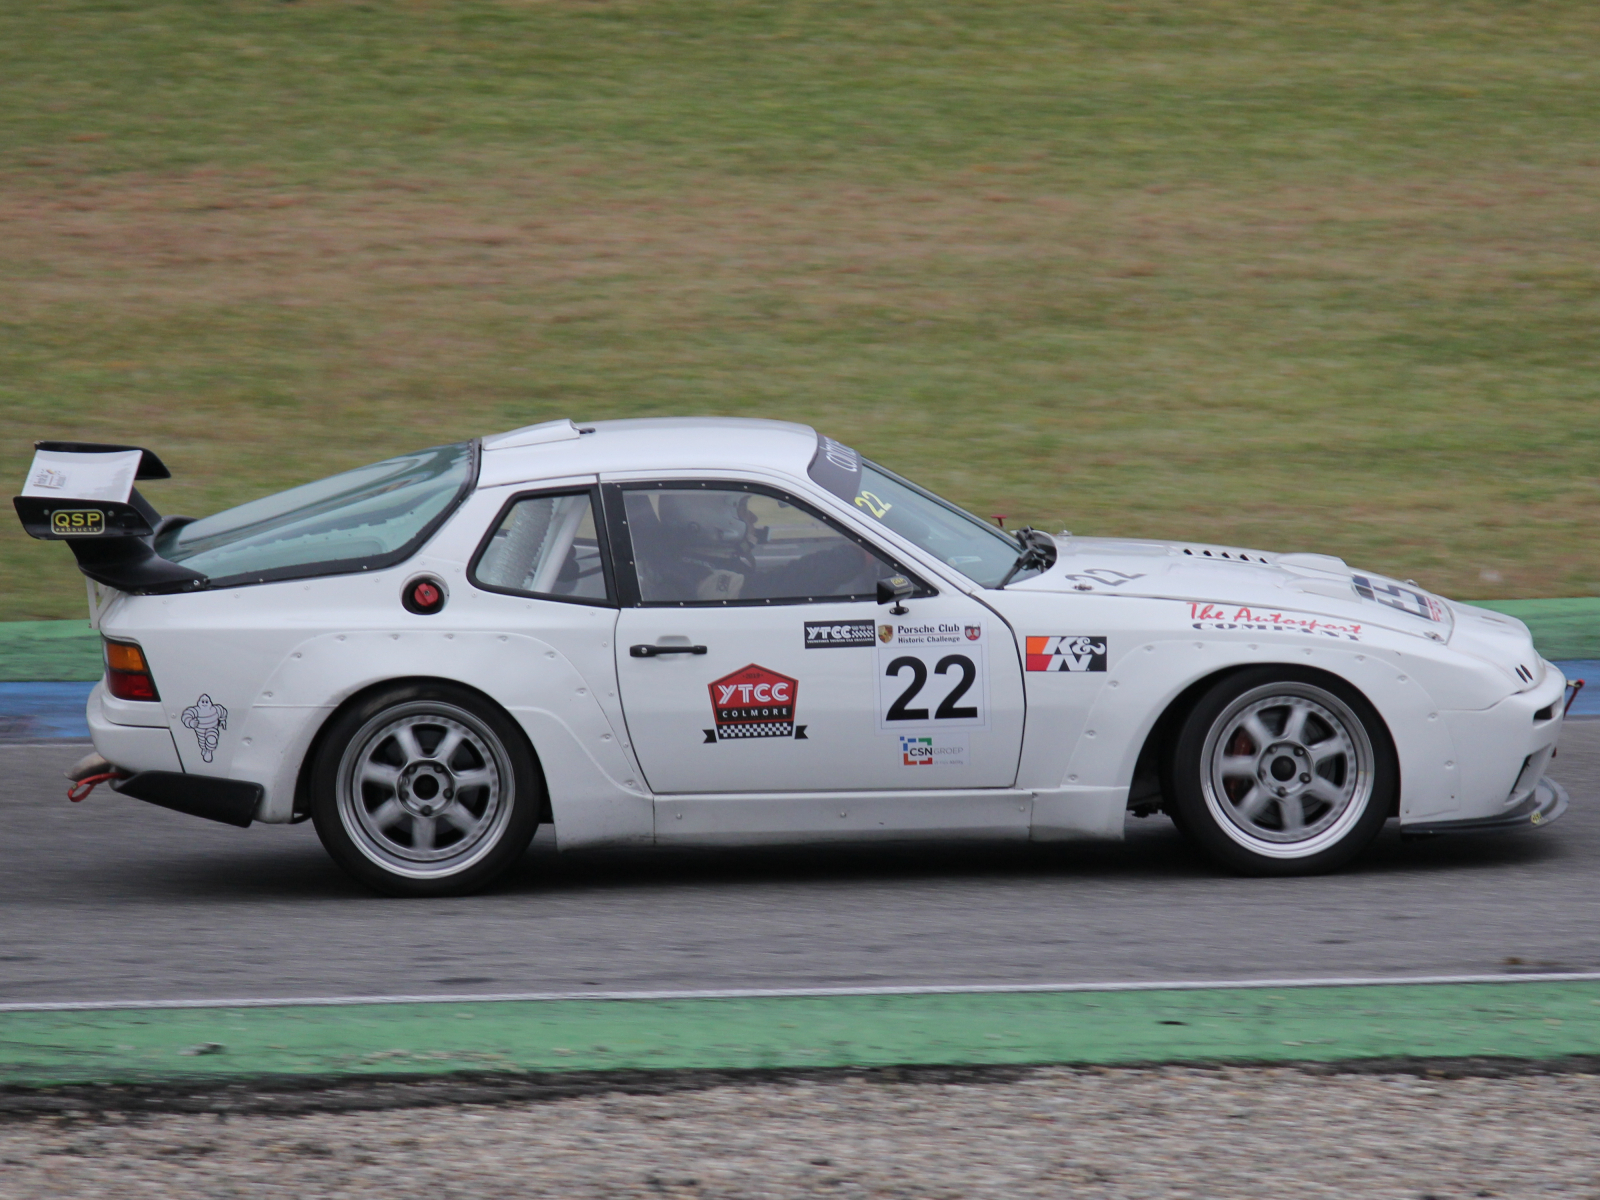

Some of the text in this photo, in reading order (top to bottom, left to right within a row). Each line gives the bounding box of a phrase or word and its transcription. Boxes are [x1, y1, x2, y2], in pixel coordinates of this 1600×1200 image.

[854, 490, 892, 518] 22
[54, 513, 101, 528] QSP
[1065, 568, 1146, 586] 22
[1186, 602, 1362, 635] The Autosport
[806, 625, 852, 640] YTCC
[897, 623, 960, 635] Porsche Club
[897, 635, 961, 644] Historic Challenge
[717, 682, 789, 705] YTCC
[886, 654, 978, 721] 22
[722, 707, 787, 717] COLMORE
